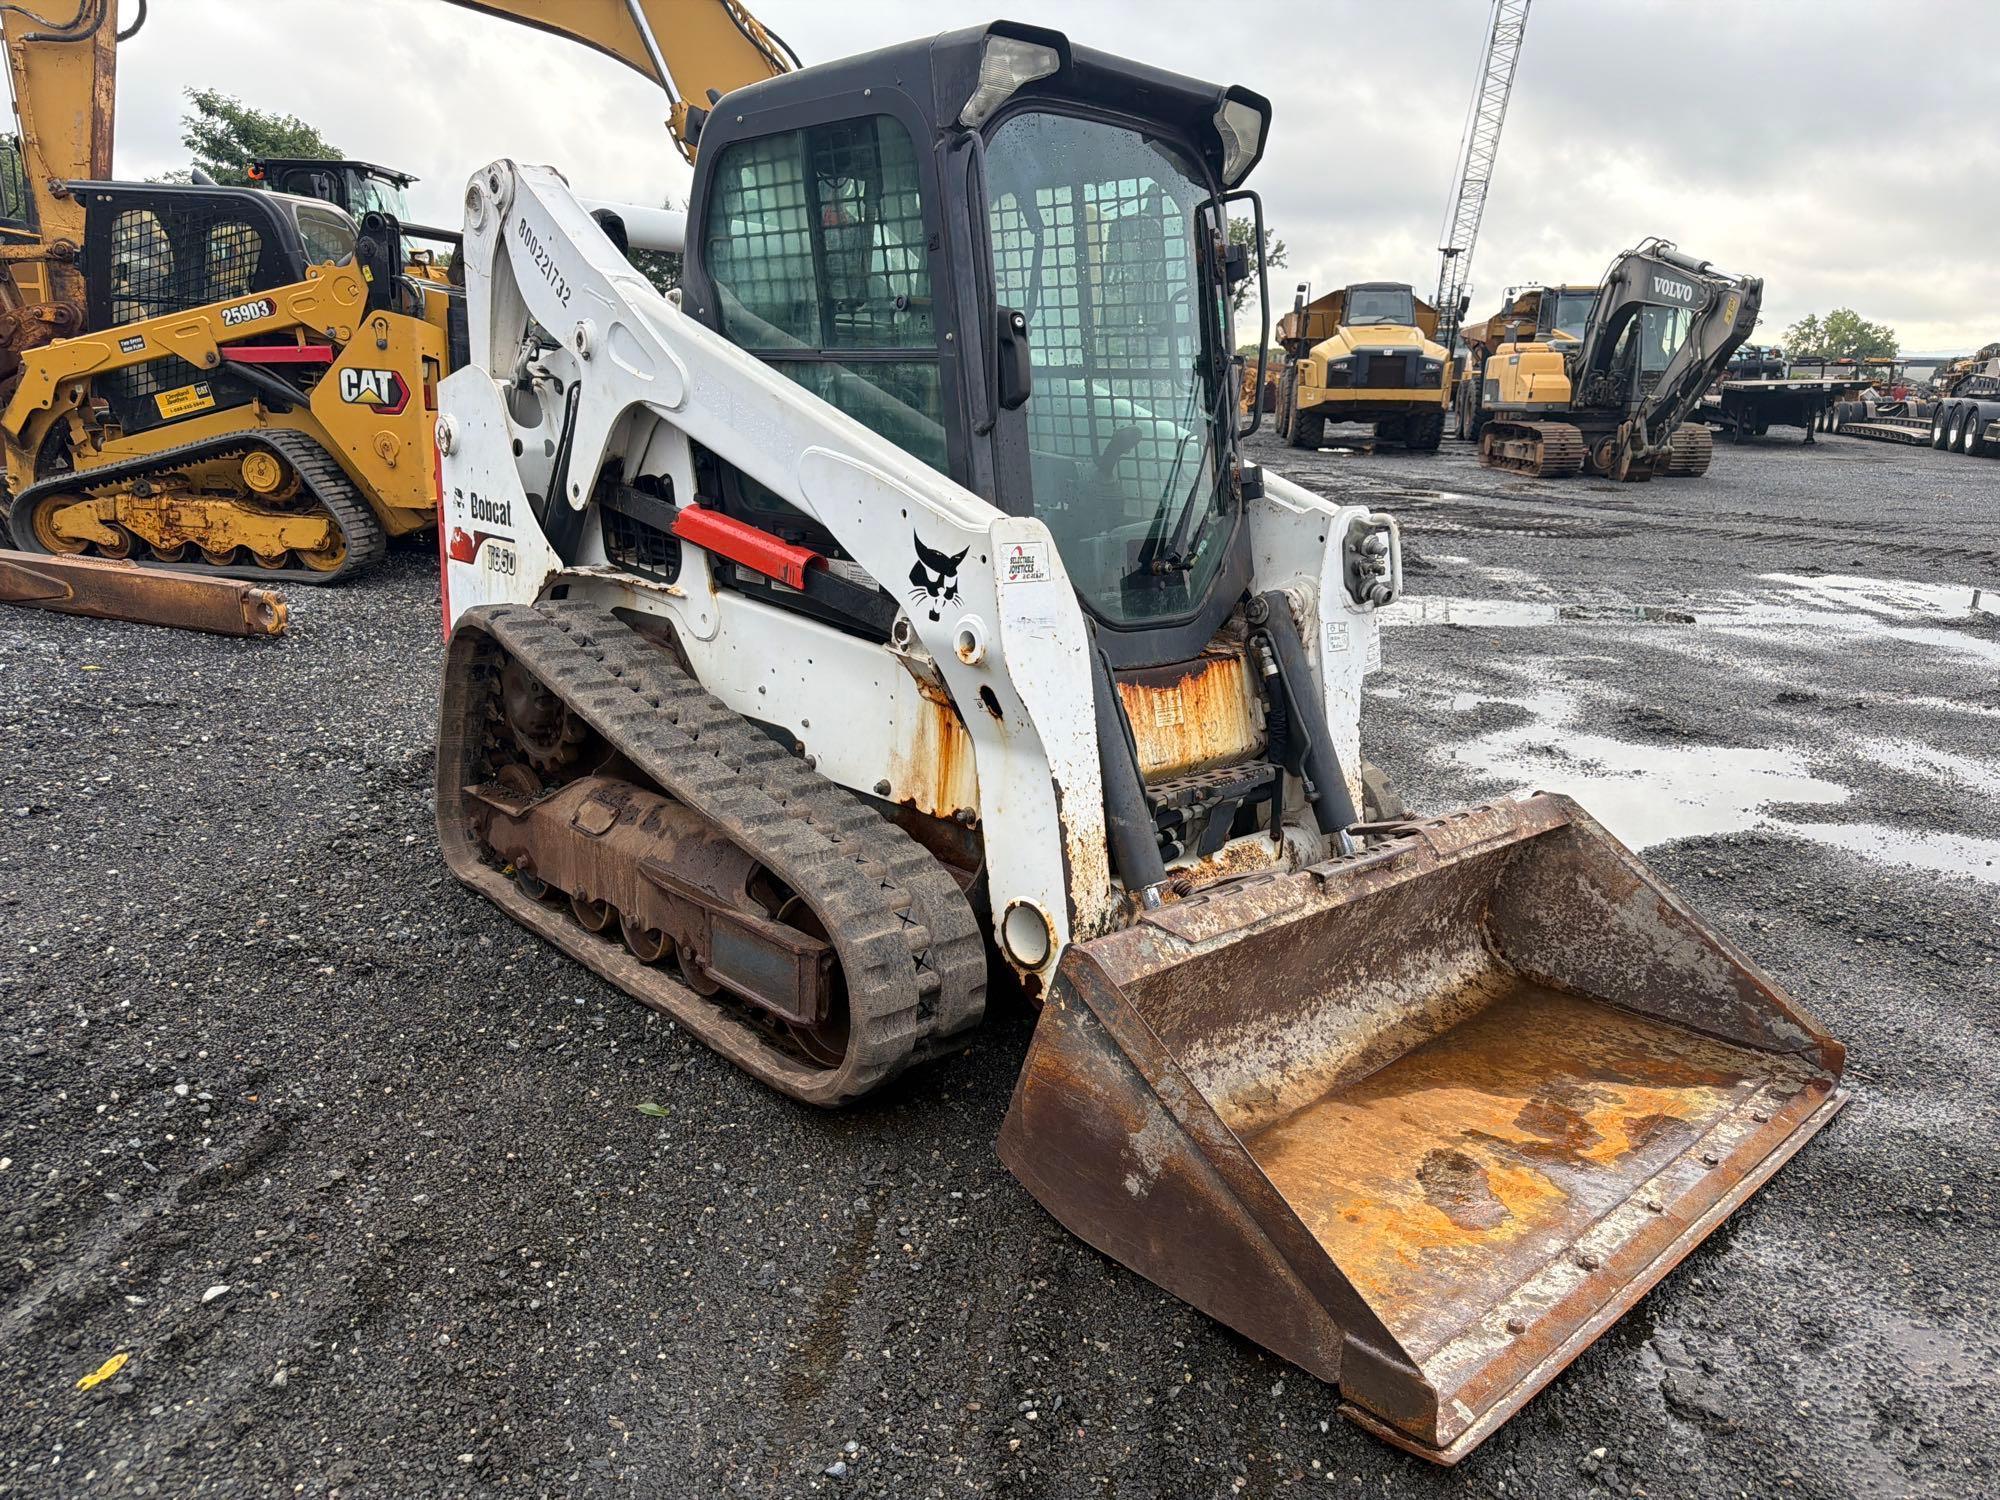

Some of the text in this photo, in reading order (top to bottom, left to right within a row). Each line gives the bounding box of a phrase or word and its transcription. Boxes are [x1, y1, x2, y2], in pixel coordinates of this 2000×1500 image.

[1653, 276, 1693, 302] VOLVO
[221, 300, 270, 327] 259D3
[196, 385, 208, 395] CAT
[340, 368, 393, 404] CAT
[470, 492, 512, 527] Bobcat
[487, 544, 517, 576] T650
